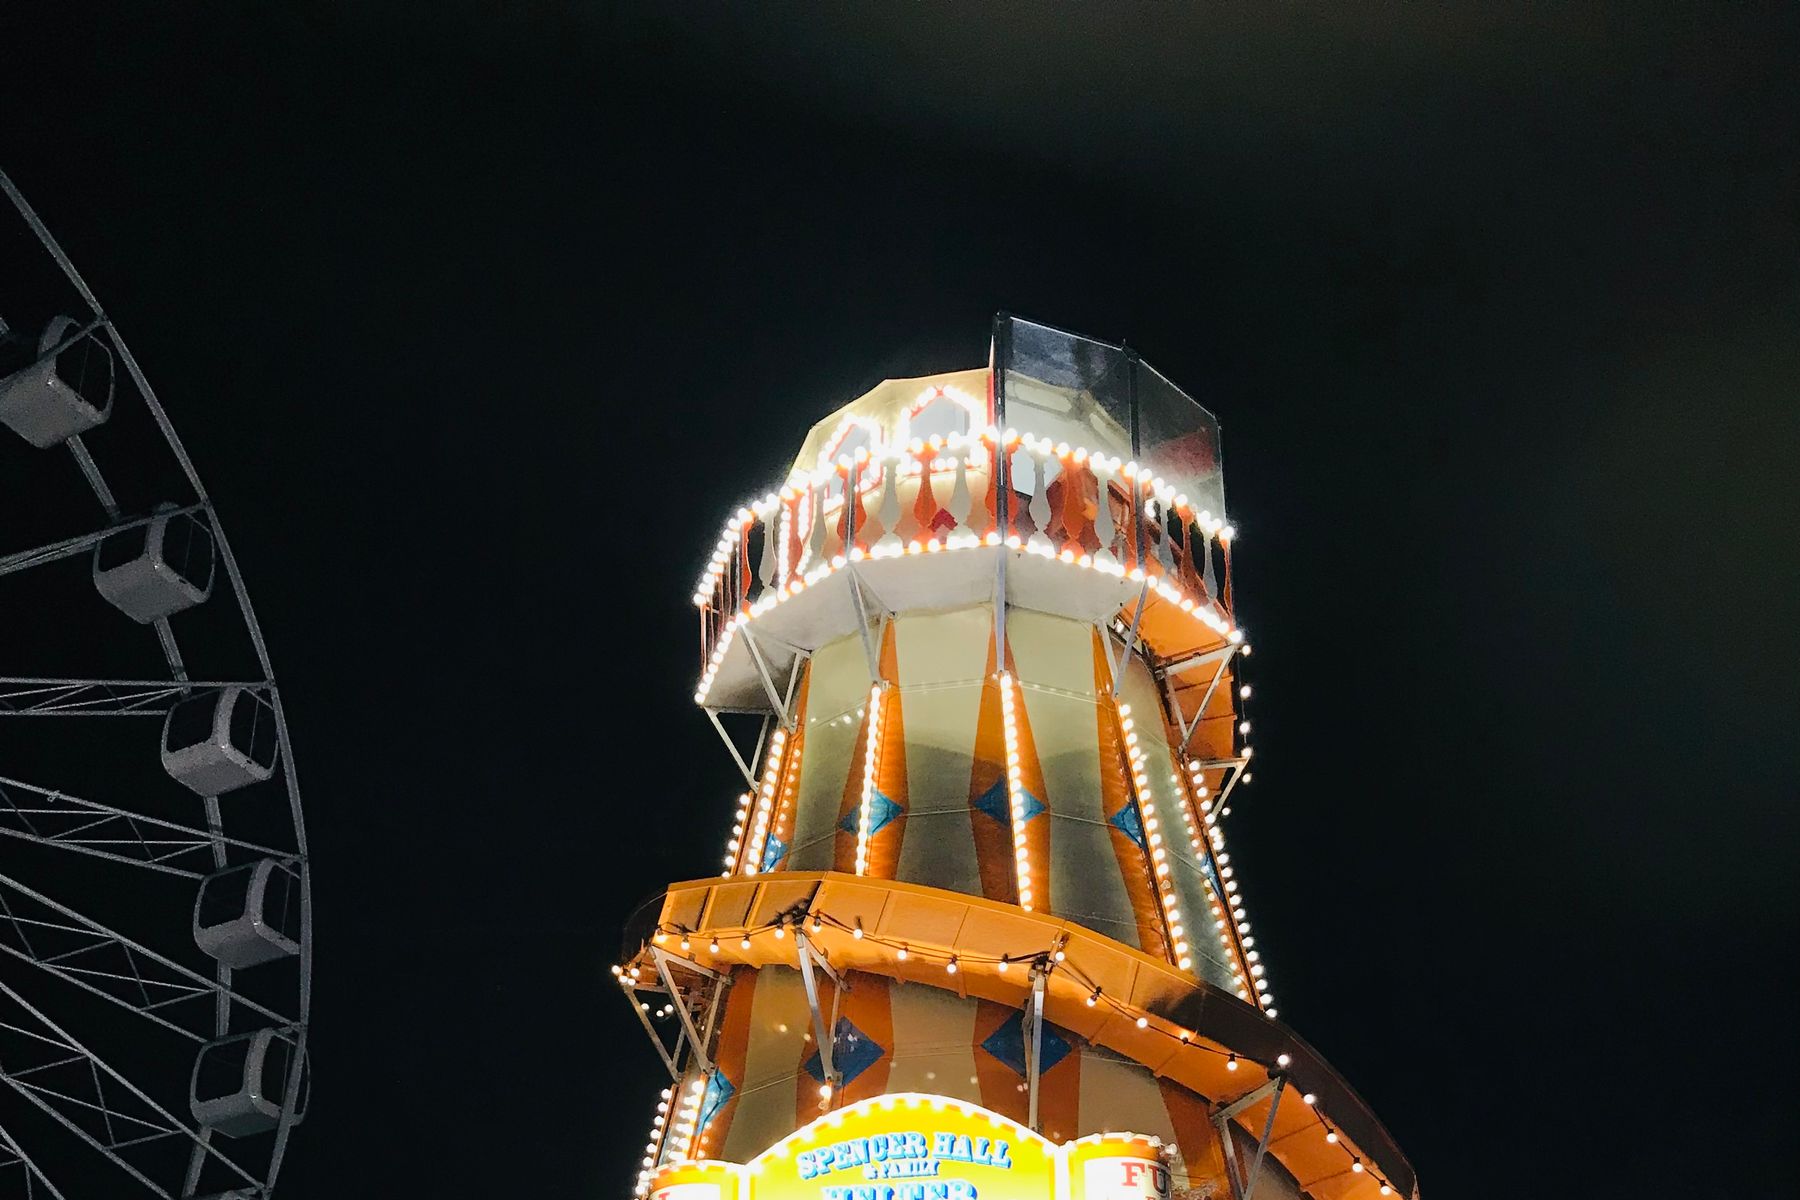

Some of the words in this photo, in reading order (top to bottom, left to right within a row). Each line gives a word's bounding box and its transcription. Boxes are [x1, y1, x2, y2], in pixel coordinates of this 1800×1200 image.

[796, 1131, 928, 1179] SPENCER
[932, 1131, 1012, 1169] HALL
[880, 1160, 940, 1178] FAMILY
